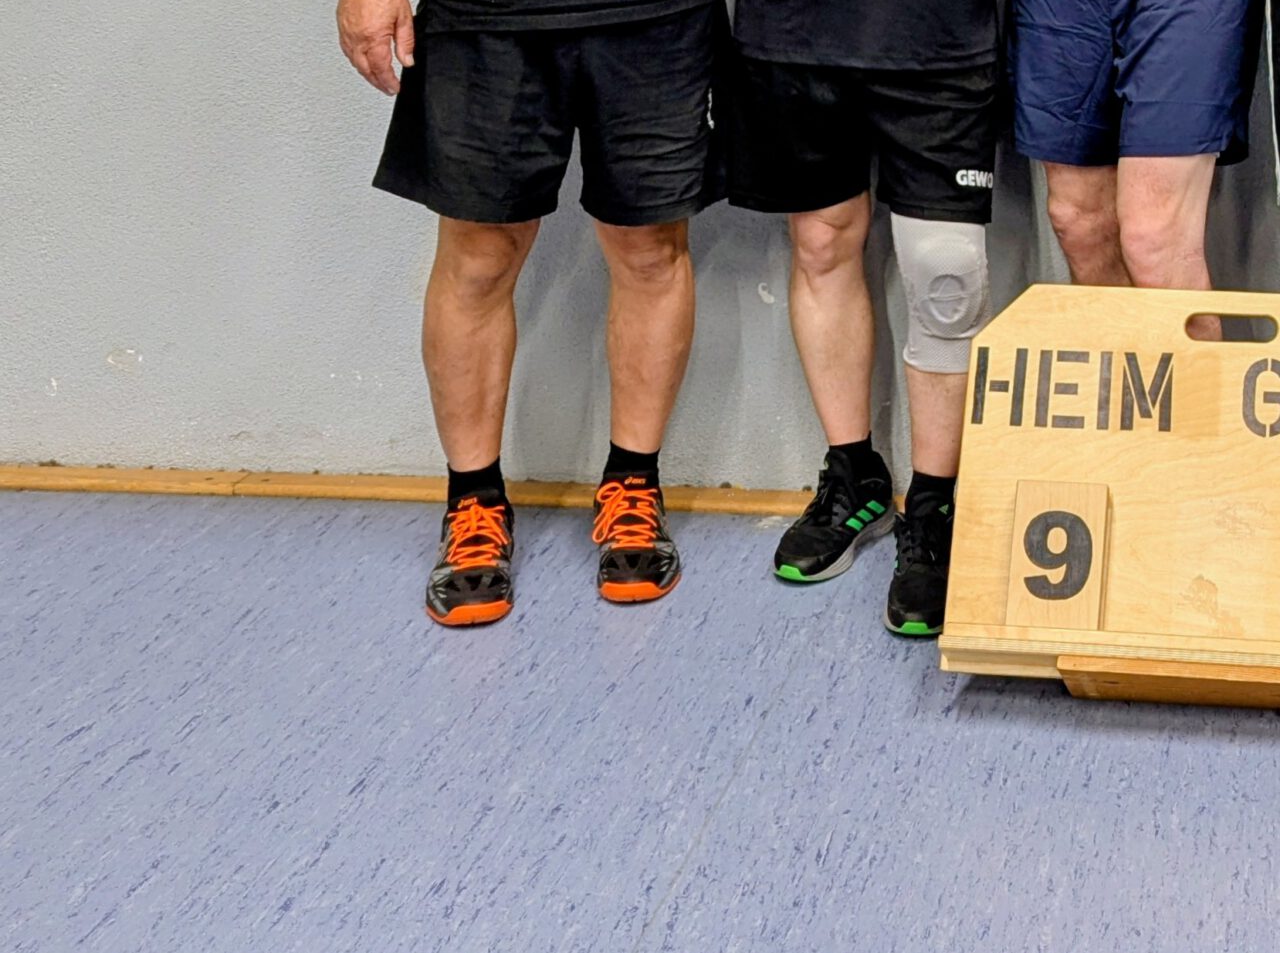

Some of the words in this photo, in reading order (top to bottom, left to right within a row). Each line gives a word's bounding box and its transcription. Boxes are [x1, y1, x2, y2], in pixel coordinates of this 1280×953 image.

[955, 169, 994, 189] GEWO
[970, 346, 1175, 432] HEIM
[1023, 510, 1093, 601] 9
